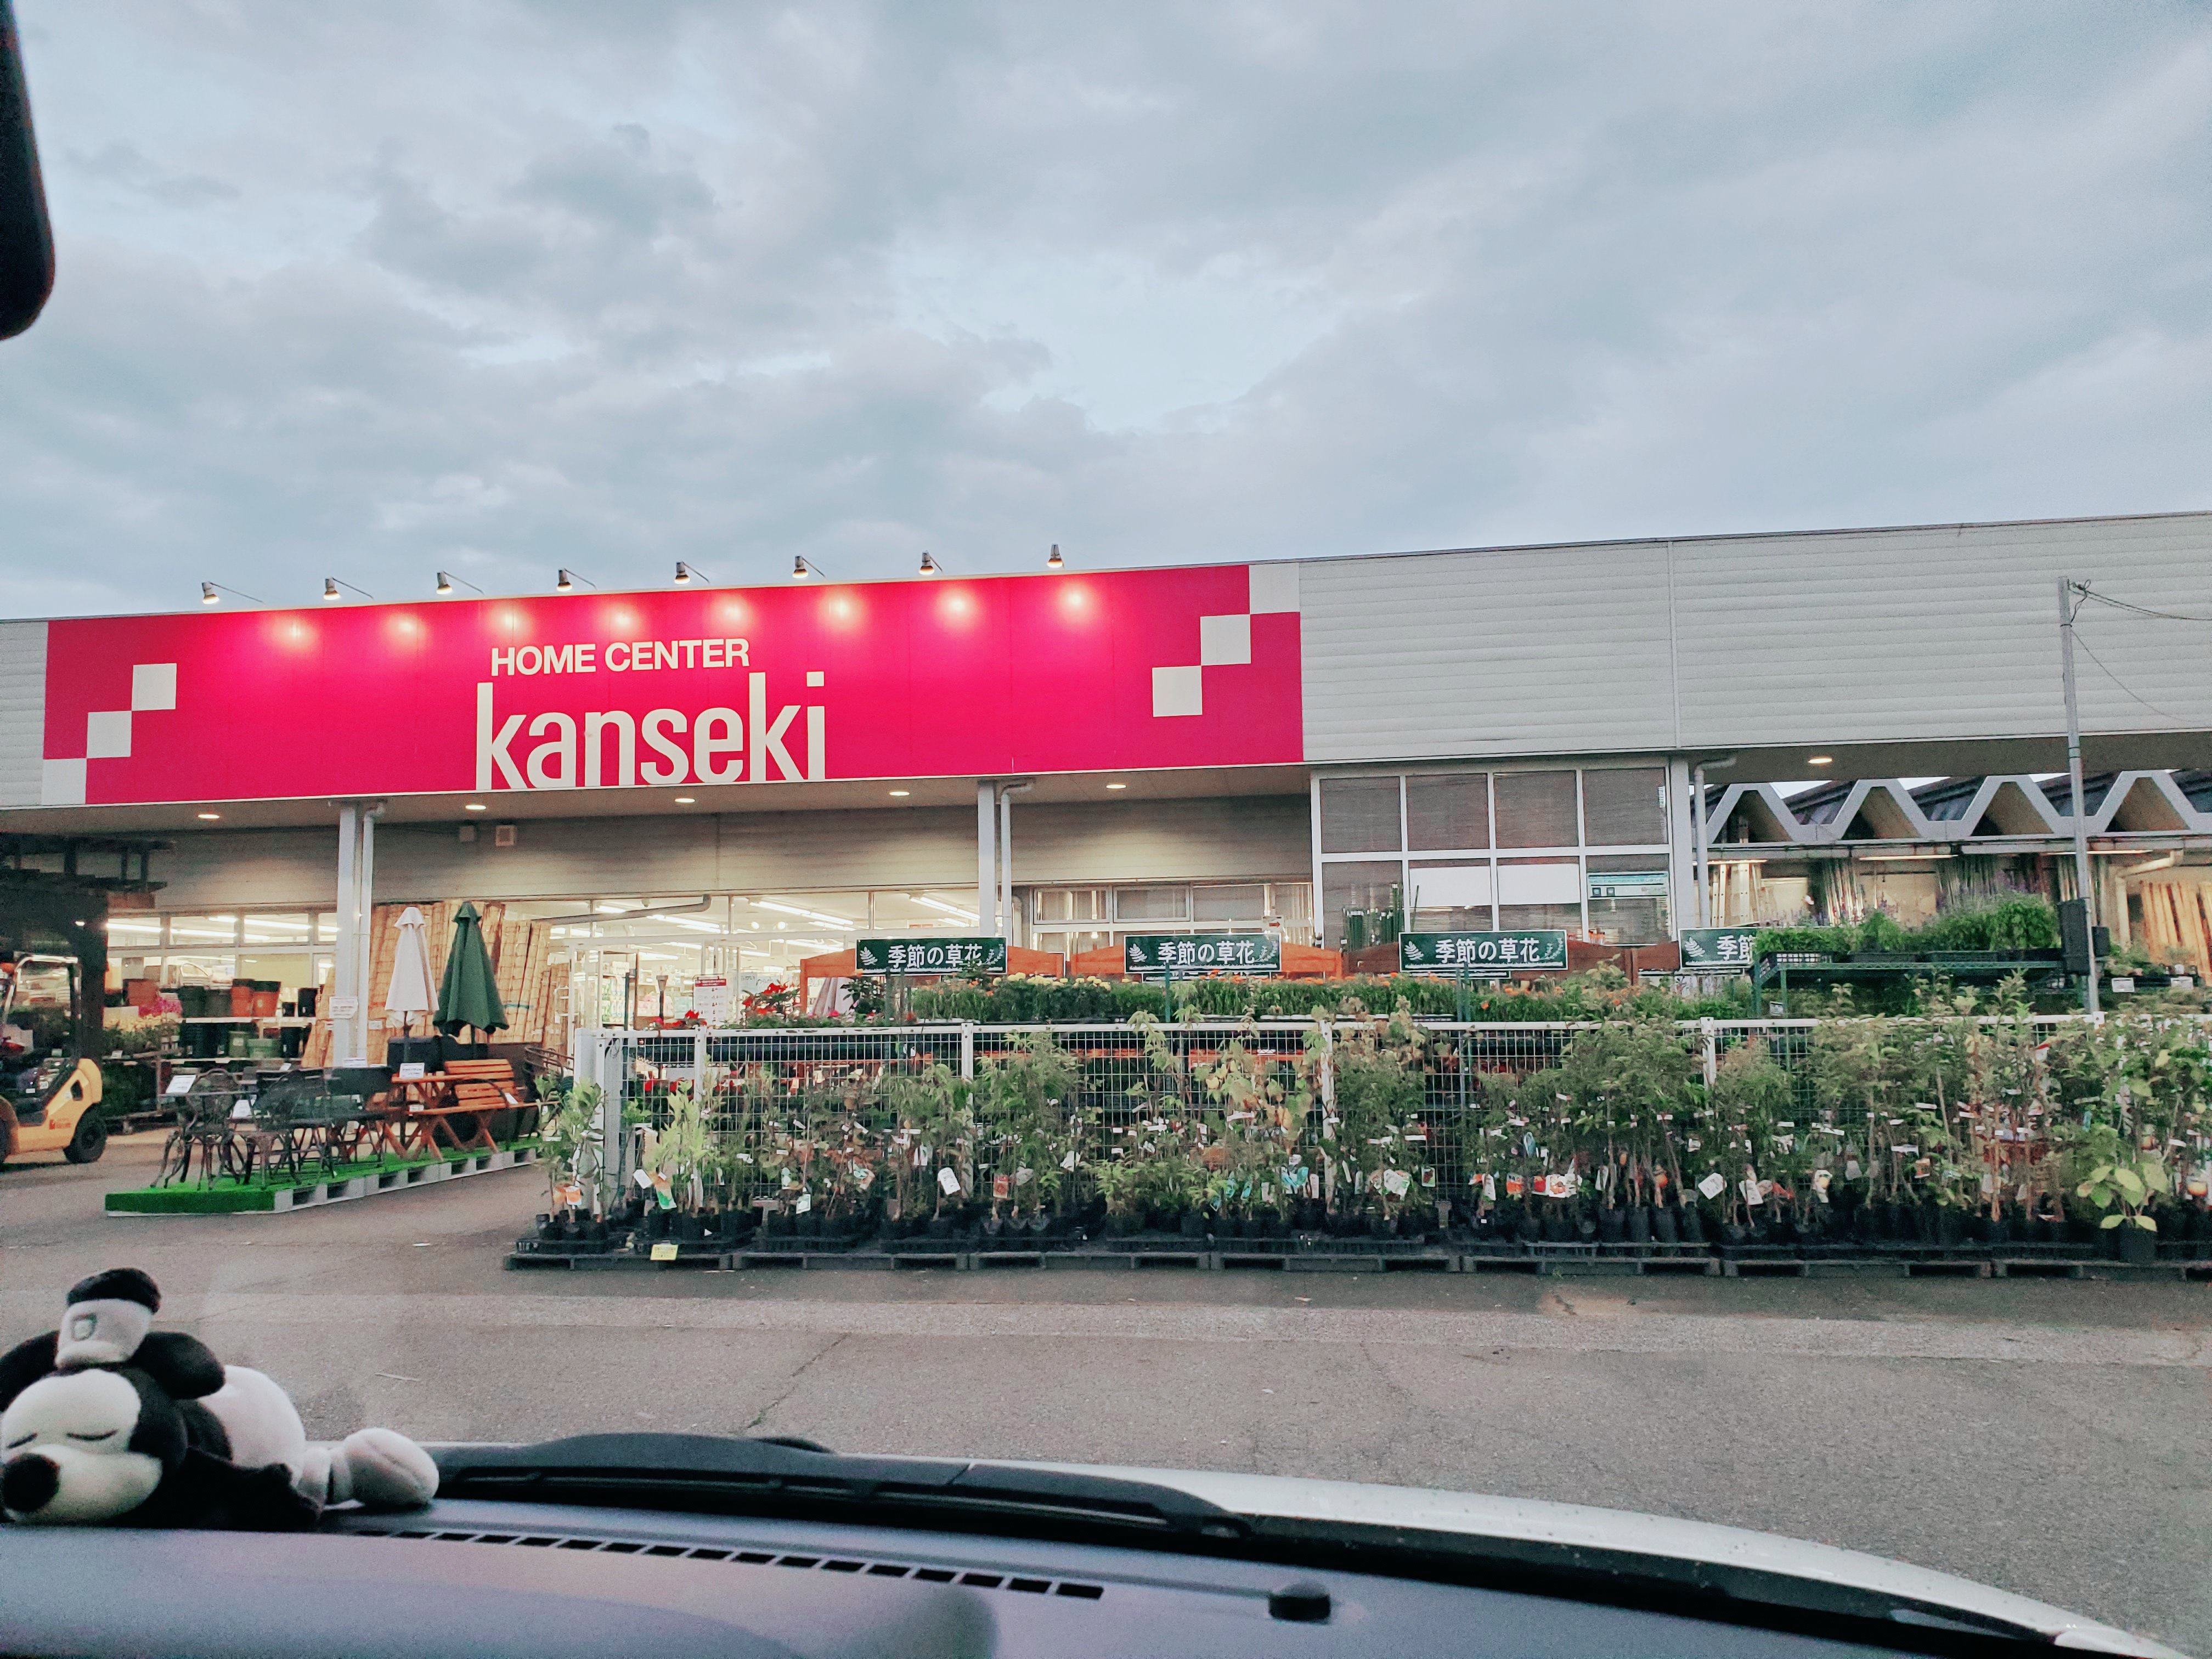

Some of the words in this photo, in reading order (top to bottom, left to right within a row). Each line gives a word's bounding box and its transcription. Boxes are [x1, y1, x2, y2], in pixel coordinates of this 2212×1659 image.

[491, 644, 596, 676] HOME
[605, 638, 750, 672] CENTER
[476, 672, 825, 790] kanseki
[888, 944, 983, 968] 季節の草花
[1158, 940, 1255, 965] 季節の草花
[1435, 937, 1540, 963] 季節の草花
[1717, 934, 1756, 961] 季節
